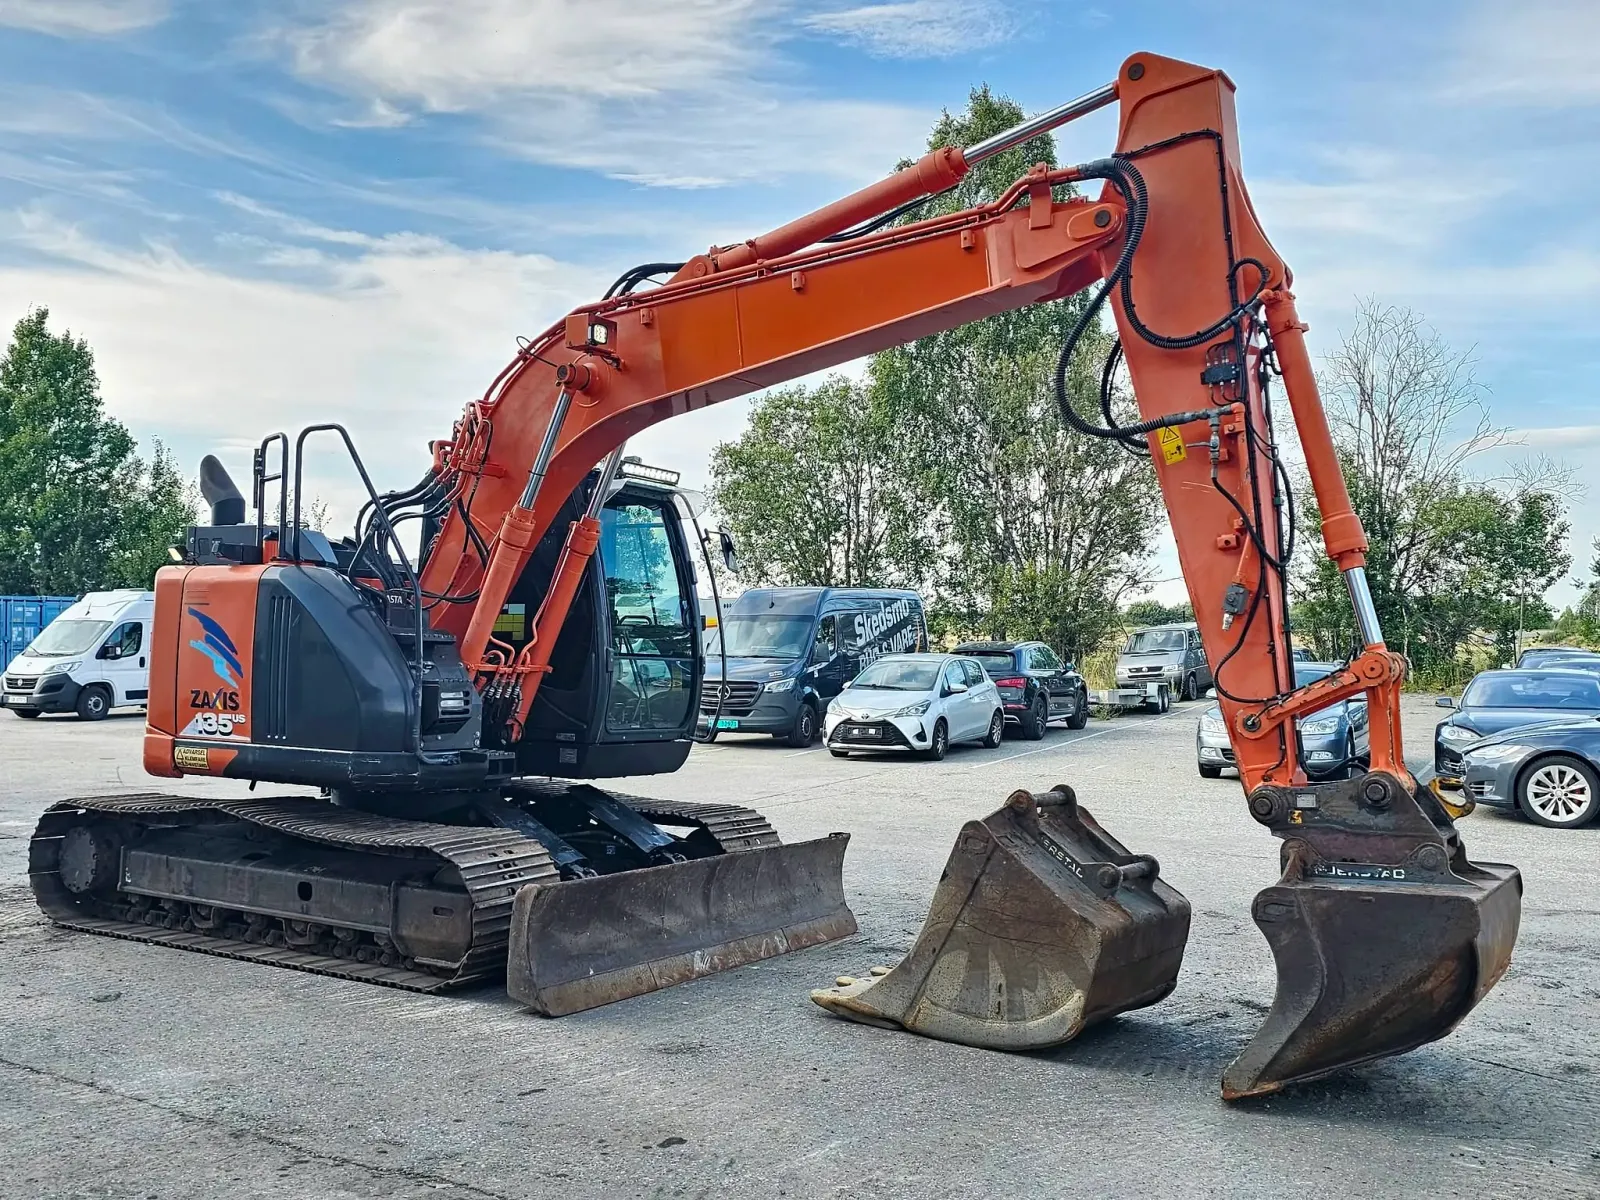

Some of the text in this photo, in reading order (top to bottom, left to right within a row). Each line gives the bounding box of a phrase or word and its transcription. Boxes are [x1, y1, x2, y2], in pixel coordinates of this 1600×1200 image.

[854, 597, 910, 647] Skedsmo
[889, 624, 914, 653] VARE
[190, 687, 240, 711] ZAXIS
